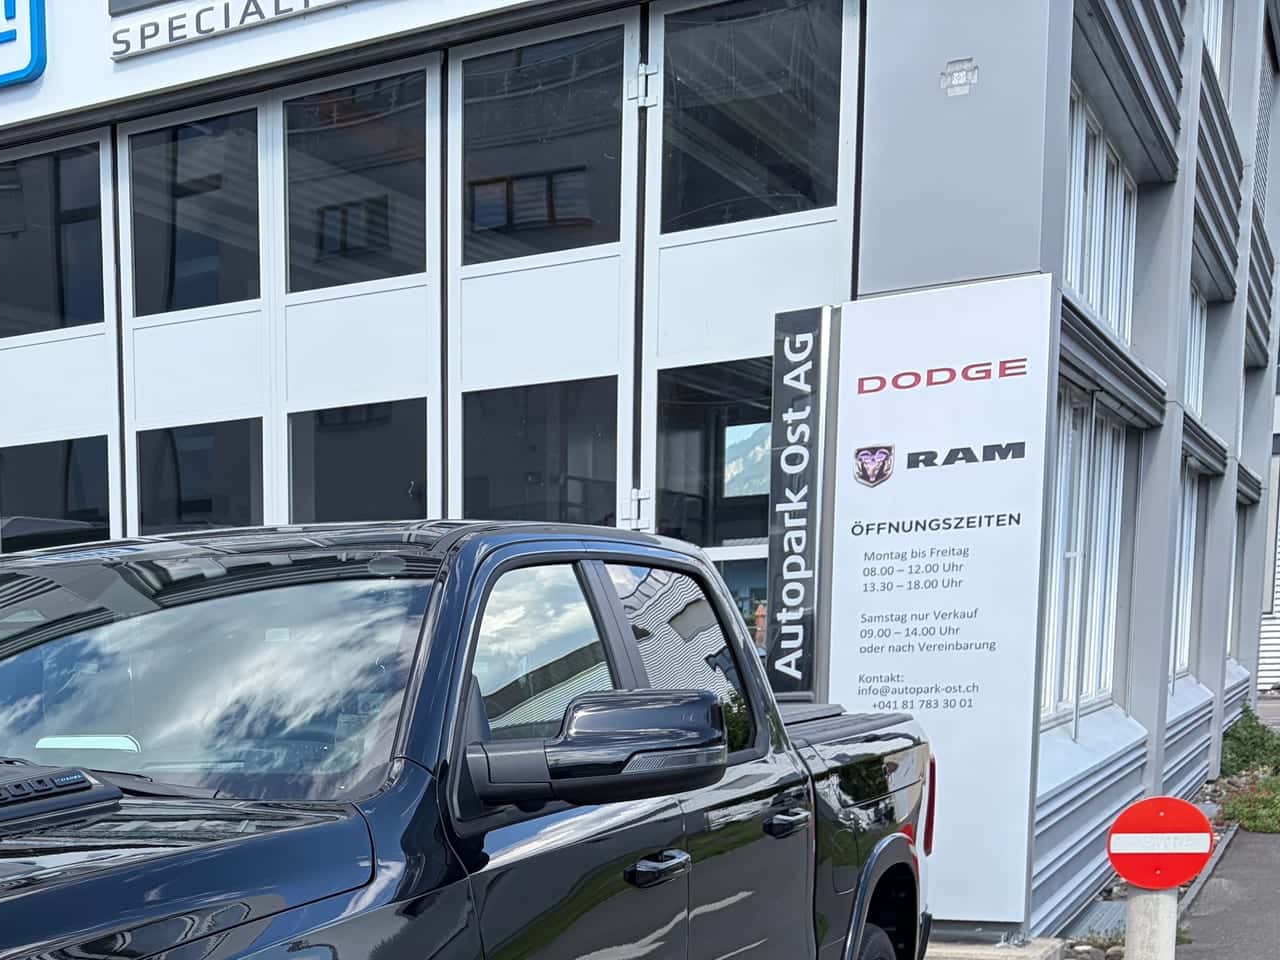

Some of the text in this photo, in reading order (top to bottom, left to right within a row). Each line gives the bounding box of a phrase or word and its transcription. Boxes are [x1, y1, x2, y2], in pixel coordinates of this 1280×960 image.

[111, 0, 310, 56] SPECIAL
[857, 358, 1028, 395] DODGE
[906, 441, 1026, 469] RAM
[775, 331, 814, 681] Autopark Ost AG
[851, 513, 1021, 536] ÖFFNUNGSZEITEN
[864, 547, 970, 561] Montag bis Freitag
[863, 566, 894, 577] 08.00
[907, 564, 939, 575] 12.00
[942, 562, 964, 573] Uhr
[863, 582, 893, 592] 13.30
[907, 580, 938, 590] 18.00
[941, 579, 963, 588] Uhr
[860, 608, 978, 624] Samstag nur Verkauf
[860, 628, 891, 639] 09.00
[904, 627, 936, 637] 14.00
[939, 626, 960, 636] Uhr
[859, 640, 997, 654] oder nach Vereinbarung
[858, 673, 904, 683] Kontakt:
[858, 683, 979, 696] info@autopark-ost.ch
[872, 698, 973, 711] +041 81 783 30 01
